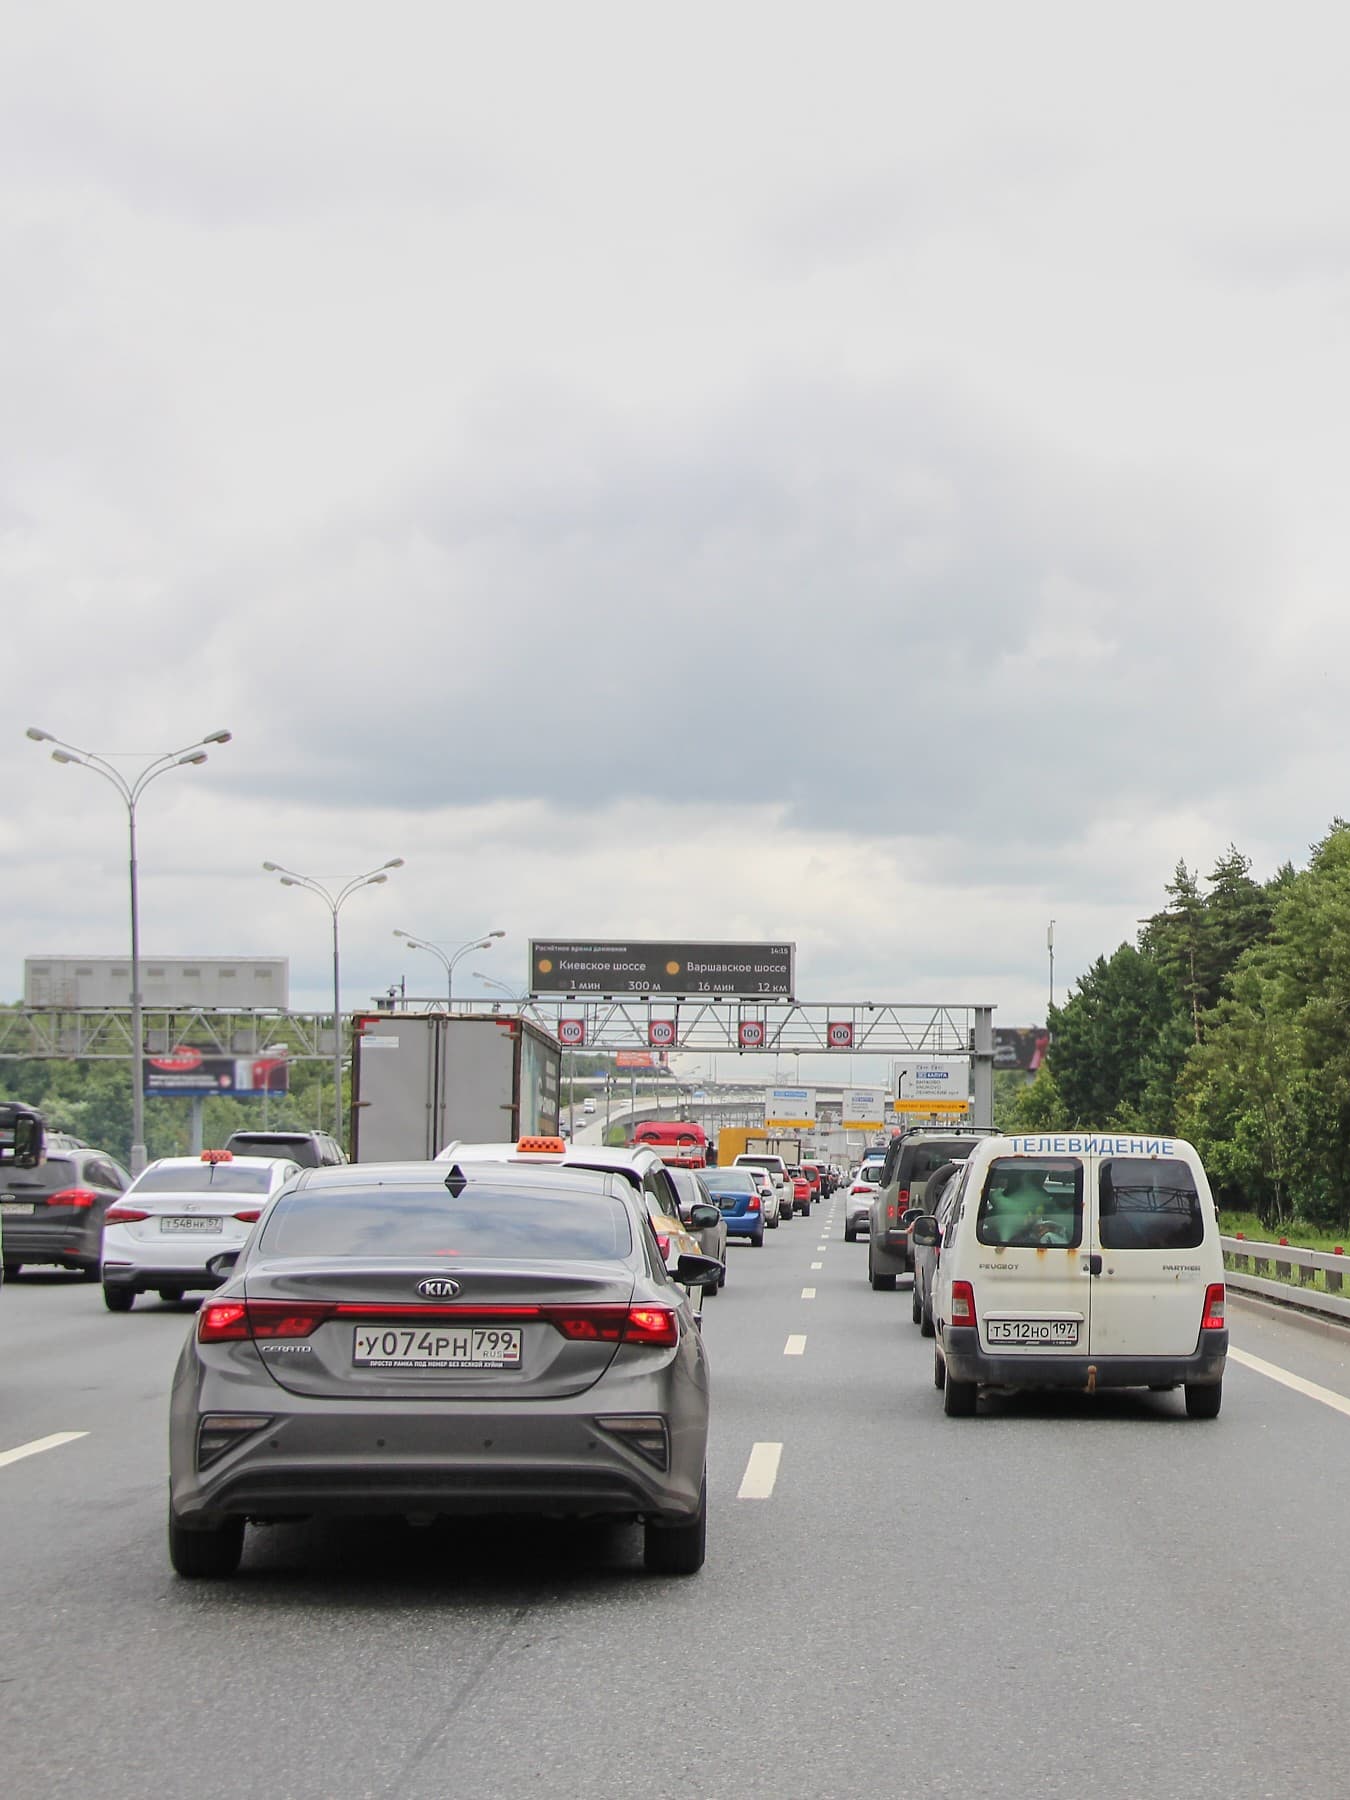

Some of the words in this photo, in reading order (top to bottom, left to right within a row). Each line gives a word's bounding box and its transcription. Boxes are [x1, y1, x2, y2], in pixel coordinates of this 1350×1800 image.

[559, 959, 610, 971] Киевское
[613, 962, 646, 971] шоссе
[687, 961, 752, 973] Варшавское
[754, 963, 787, 973] шоссе
[570, 979, 577, 990] 1
[578, 981, 601, 990] мин
[628, 980, 650, 991] 300
[652, 982, 661, 991] м
[698, 981, 710, 991] 16
[713, 983, 735, 991] мин
[758, 982, 770, 992] 12
[772, 984, 787, 992] км
[563, 1027, 580, 1037] 100
[653, 1028, 670, 1037] 100
[743, 1029, 760, 1038] 100
[832, 1030, 849, 1039] 100
[1010, 1138, 1174, 1156] ТЕЛЕВИДЕНИЕ
[425, 1283, 453, 1295] KIA
[1052, 1323, 1073, 1334] 197
[474, 1331, 514, 1351] 799
